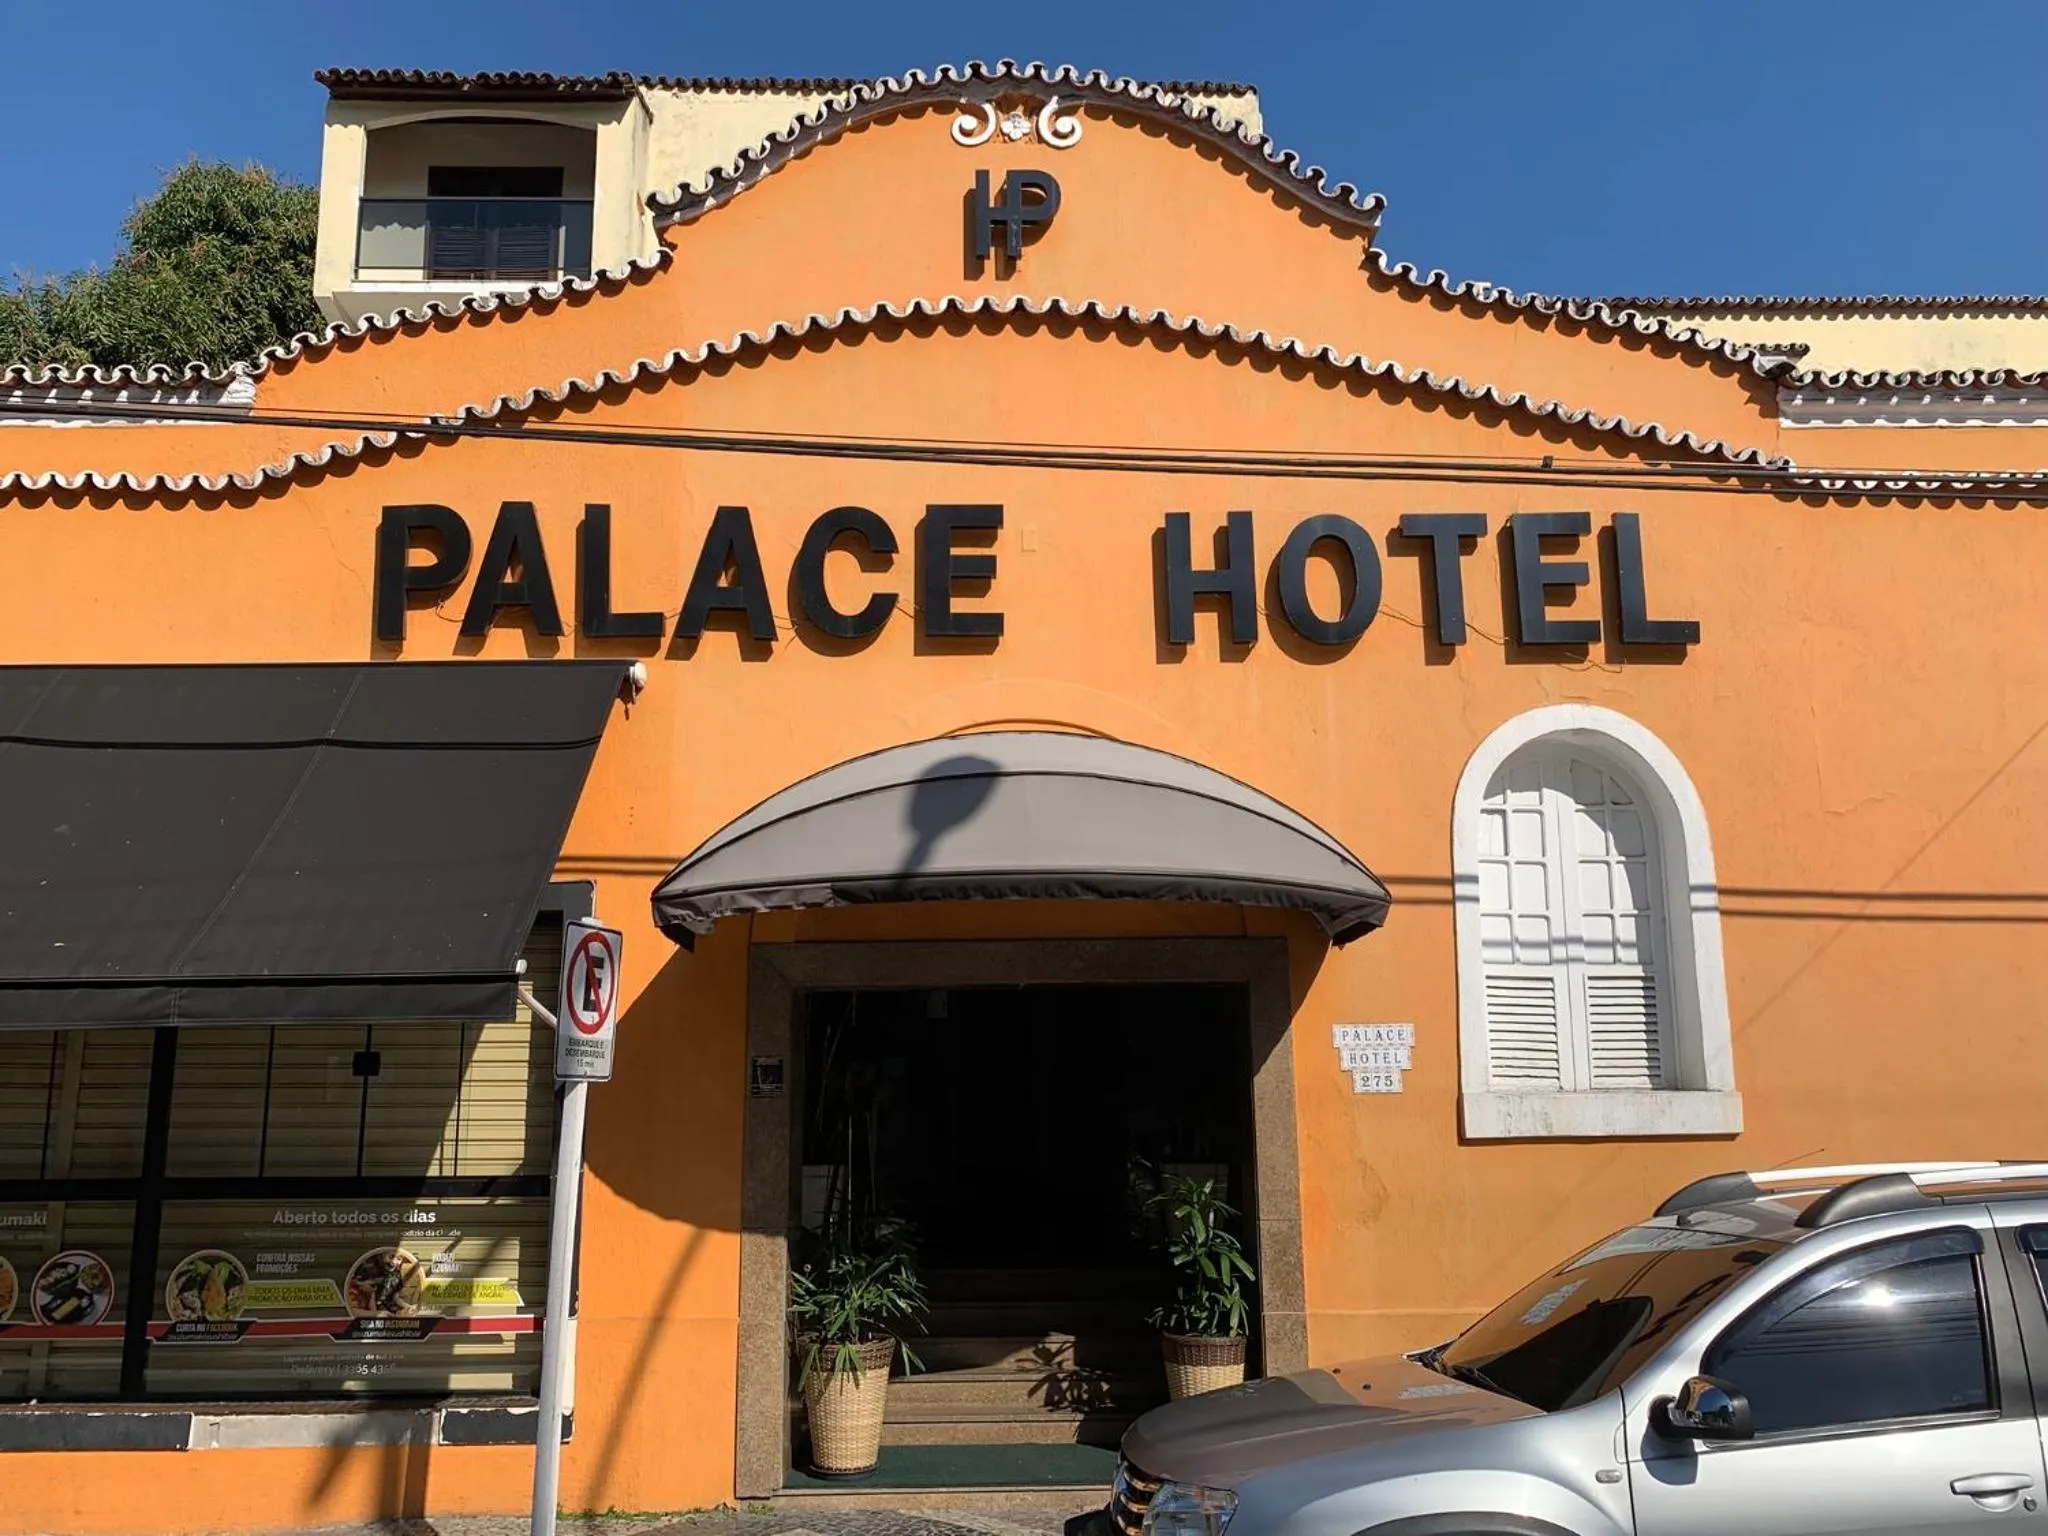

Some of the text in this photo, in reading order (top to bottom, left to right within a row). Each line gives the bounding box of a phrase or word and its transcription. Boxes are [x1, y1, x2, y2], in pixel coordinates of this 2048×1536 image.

[377, 500, 1701, 648] PALACE HOTEL
[1341, 1029, 1406, 1042] PALACE
[1349, 1052, 1402, 1065] HOTEL
[1361, 1075, 1394, 1088] 275
[273, 1208, 437, 1224] Aberto todos os dias
